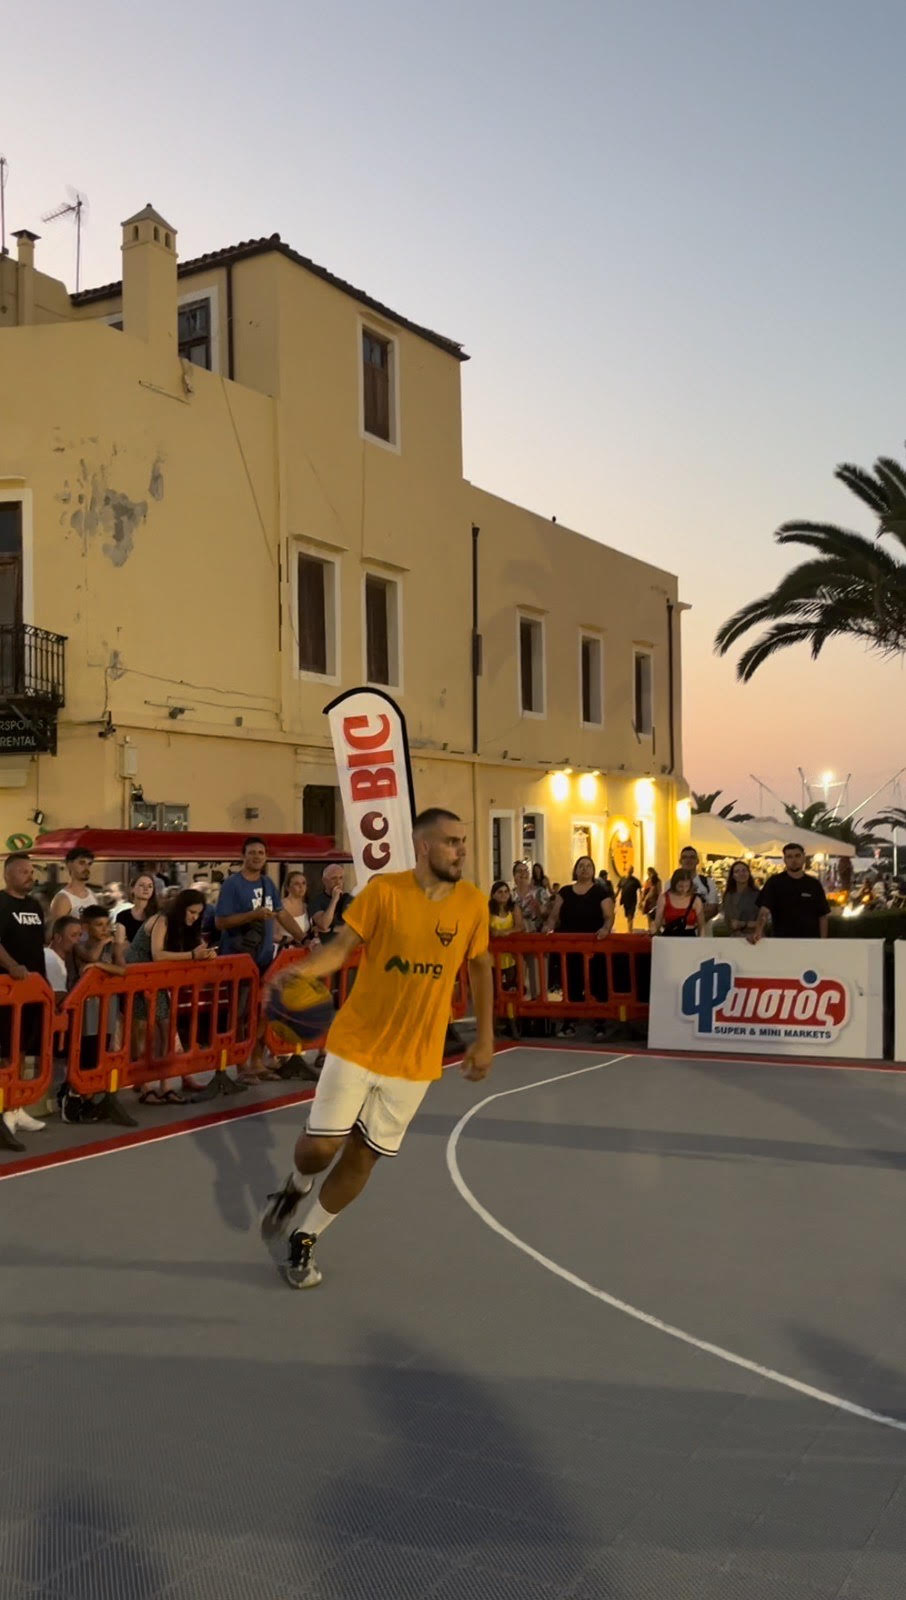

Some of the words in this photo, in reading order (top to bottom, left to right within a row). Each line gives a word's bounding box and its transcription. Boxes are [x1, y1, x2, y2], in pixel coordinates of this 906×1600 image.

[0, 735, 37, 747] RENTAL
[413, 963, 443, 980] nrg
[714, 1026, 746, 1035] SUPER
[749, 1027, 756, 1037] &
[759, 1028, 781, 1038] MINI
[784, 1029, 831, 1039] MARKETS
